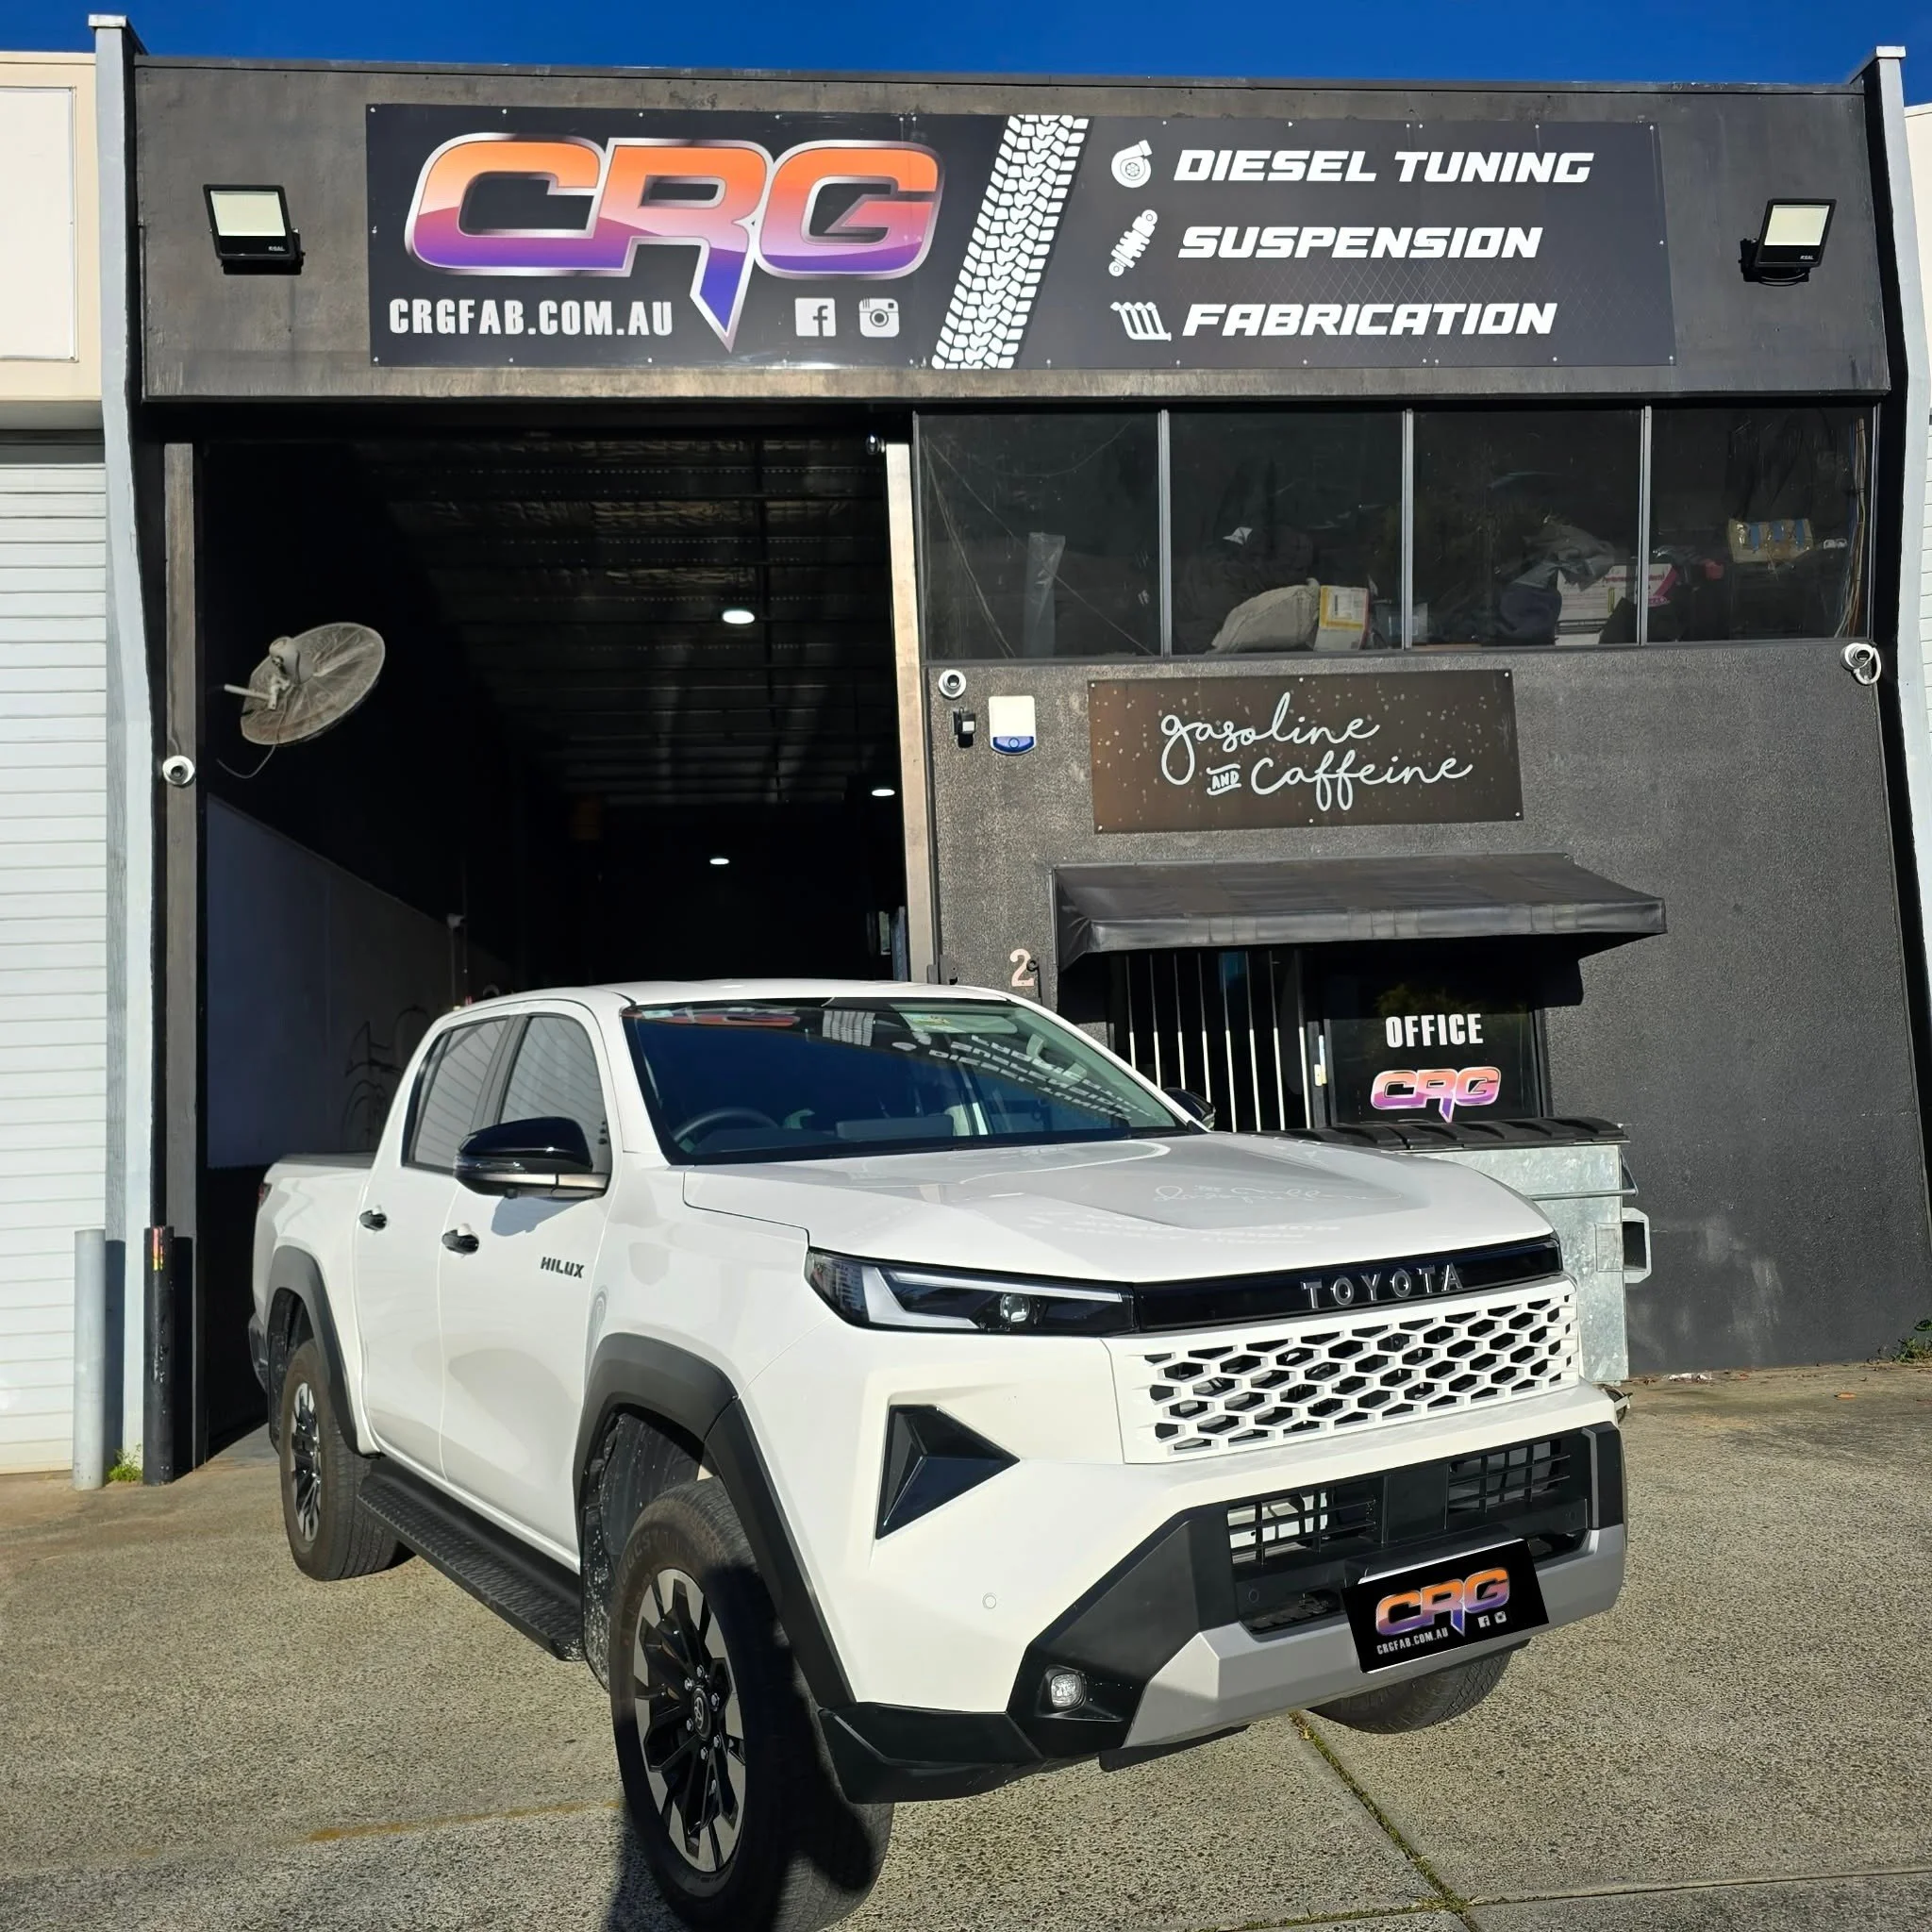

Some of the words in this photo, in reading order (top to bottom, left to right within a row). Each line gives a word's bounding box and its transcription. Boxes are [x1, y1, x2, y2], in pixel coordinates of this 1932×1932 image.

[1174, 149, 1376, 182] DIESEL
[1394, 151, 1594, 183] TUNING
[404, 133, 944, 352] CRG
[1177, 226, 1543, 258] SUSPENSION
[389, 298, 674, 336] CRGFAB.COM.AU
[1182, 302, 1558, 336] FABRICATION
[1160, 691, 1380, 785] gasoline
[1211, 772, 1239, 791] AND
[1009, 948, 1035, 988] 2
[1385, 1013, 1484, 1048] OFFICE
[1371, 1066, 1502, 1123] CRG
[540, 1257, 585, 1279] HILUX
[1300, 1262, 1463, 1309] TOYOTA
[1375, 1567, 1510, 1638] CRG
[1376, 1626, 1449, 1656] CRGFAB.COM.AU
